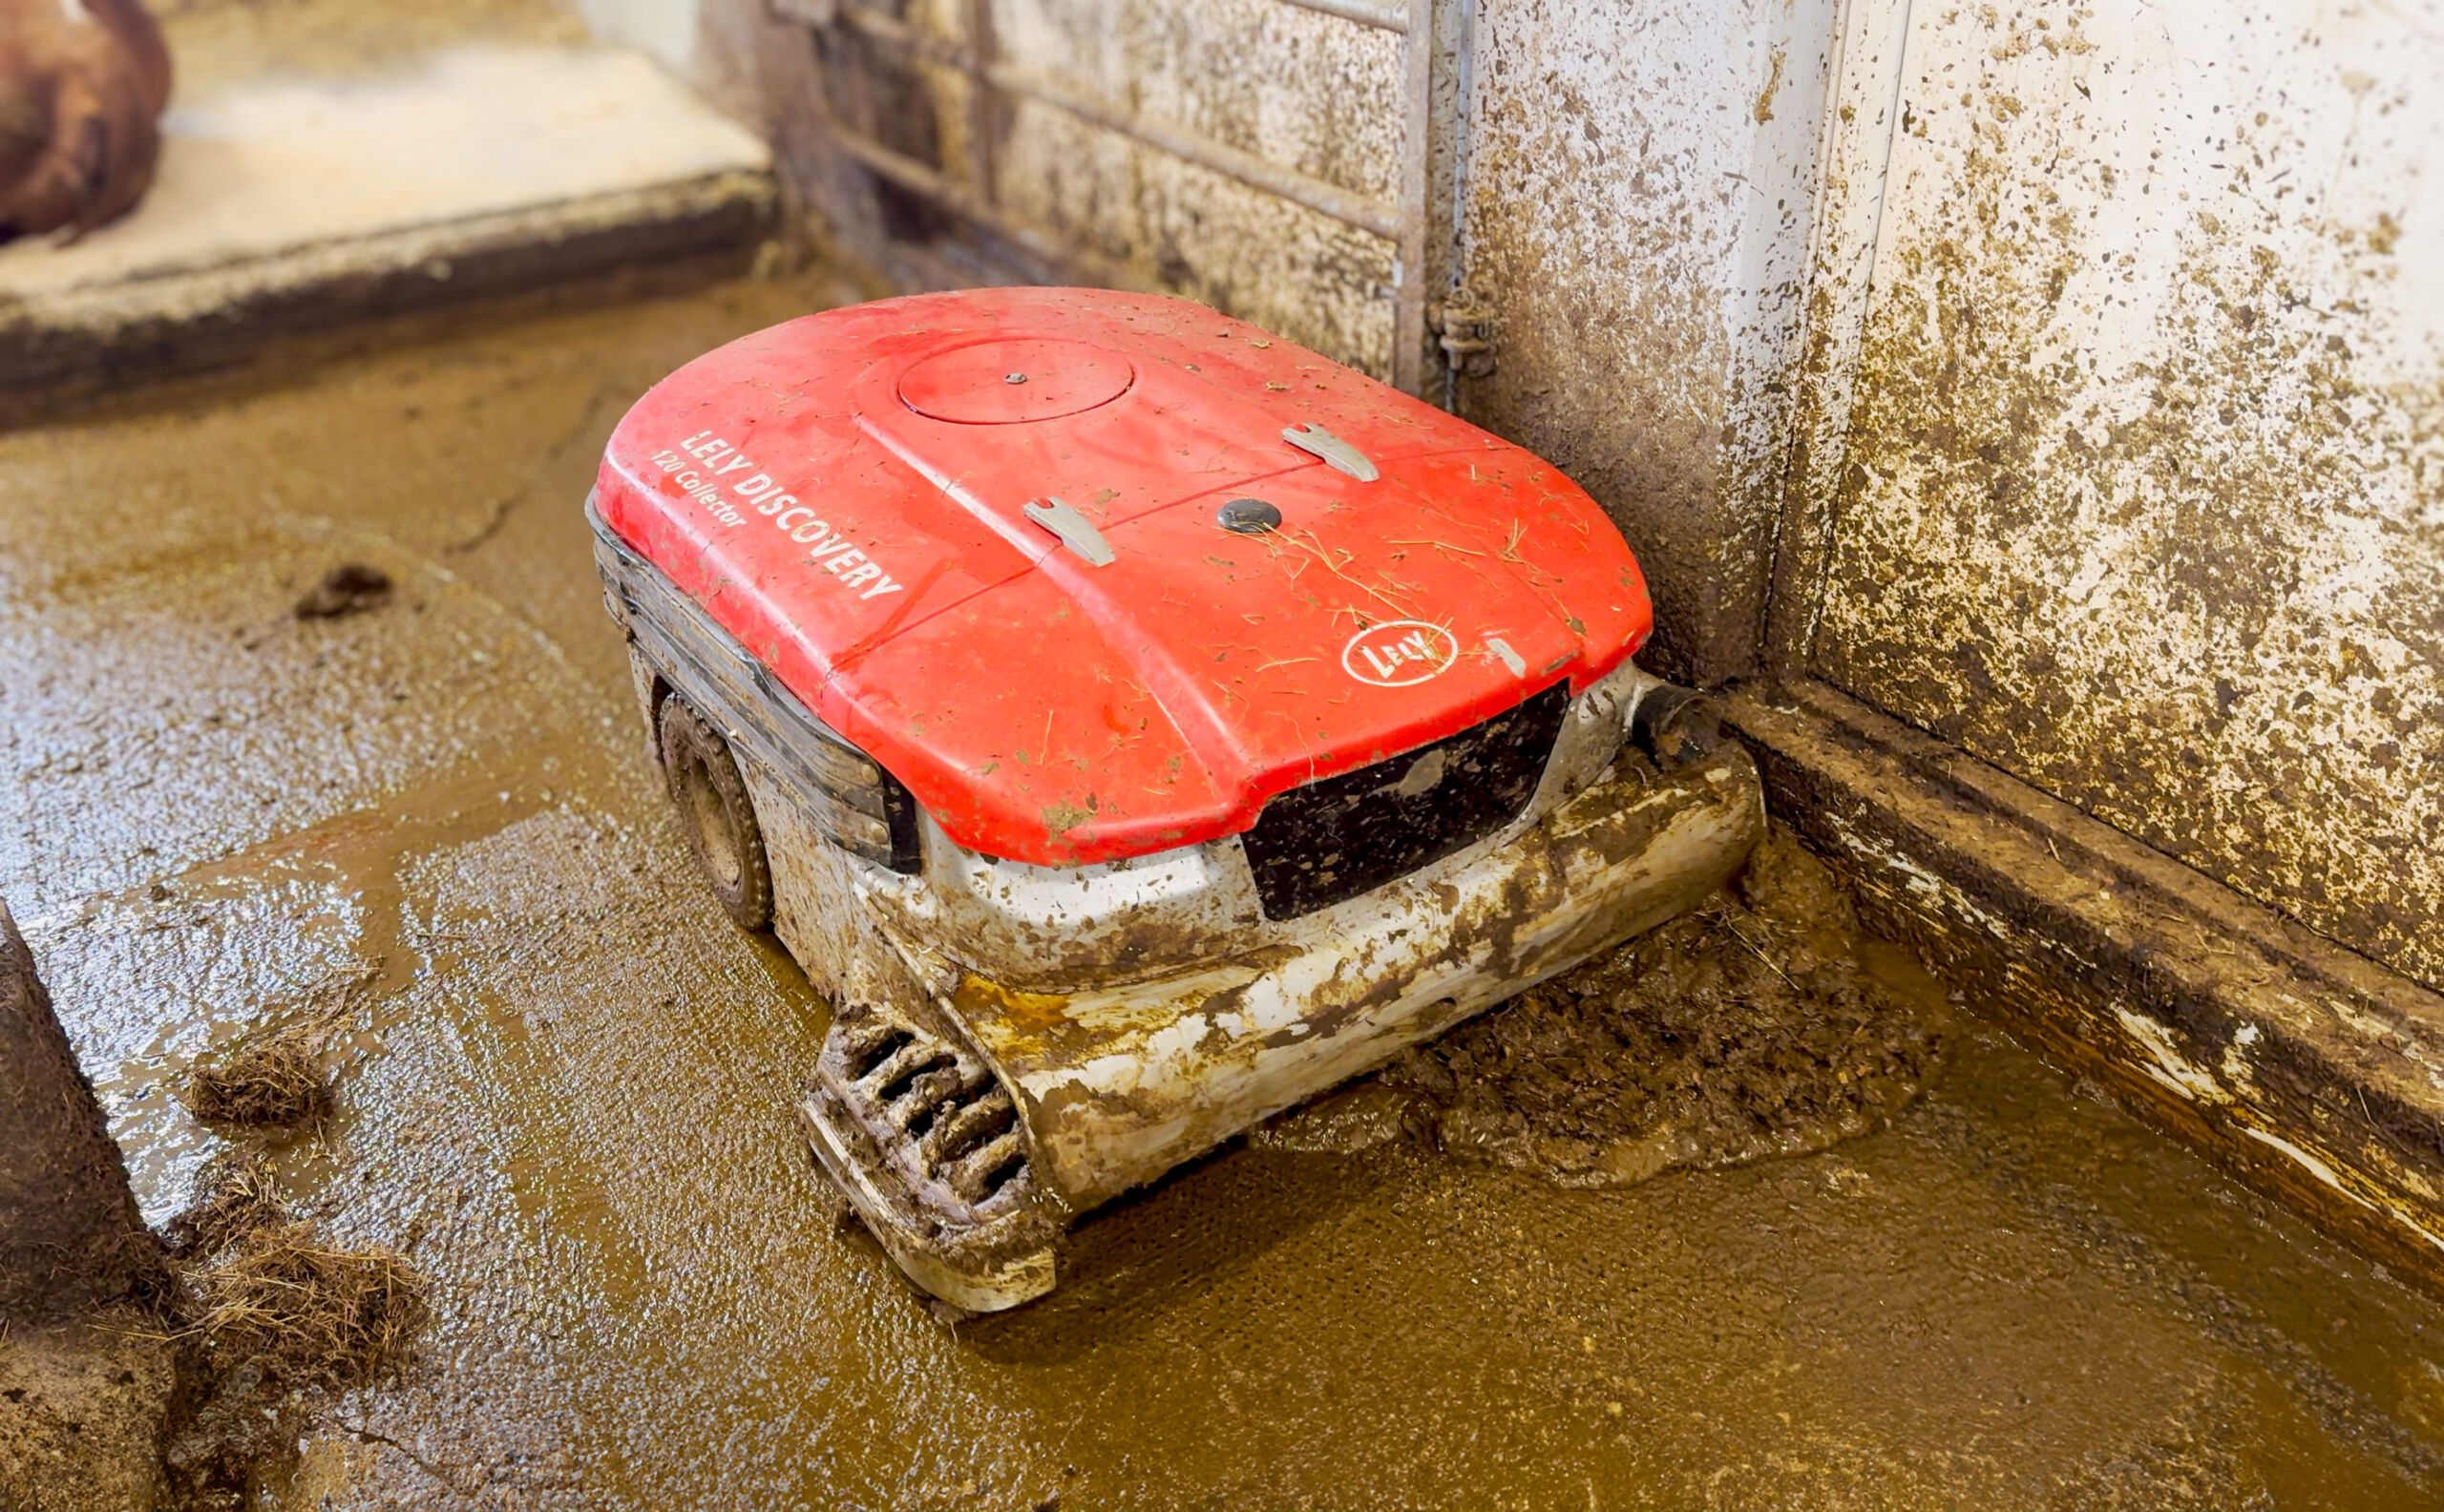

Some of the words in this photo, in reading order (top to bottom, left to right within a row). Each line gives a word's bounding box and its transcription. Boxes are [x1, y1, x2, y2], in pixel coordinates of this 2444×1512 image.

[650, 450, 685, 472] 120
[675, 471, 748, 528] Collector
[681, 430, 752, 475] LELY
[733, 473, 902, 600] DISCOVERY
